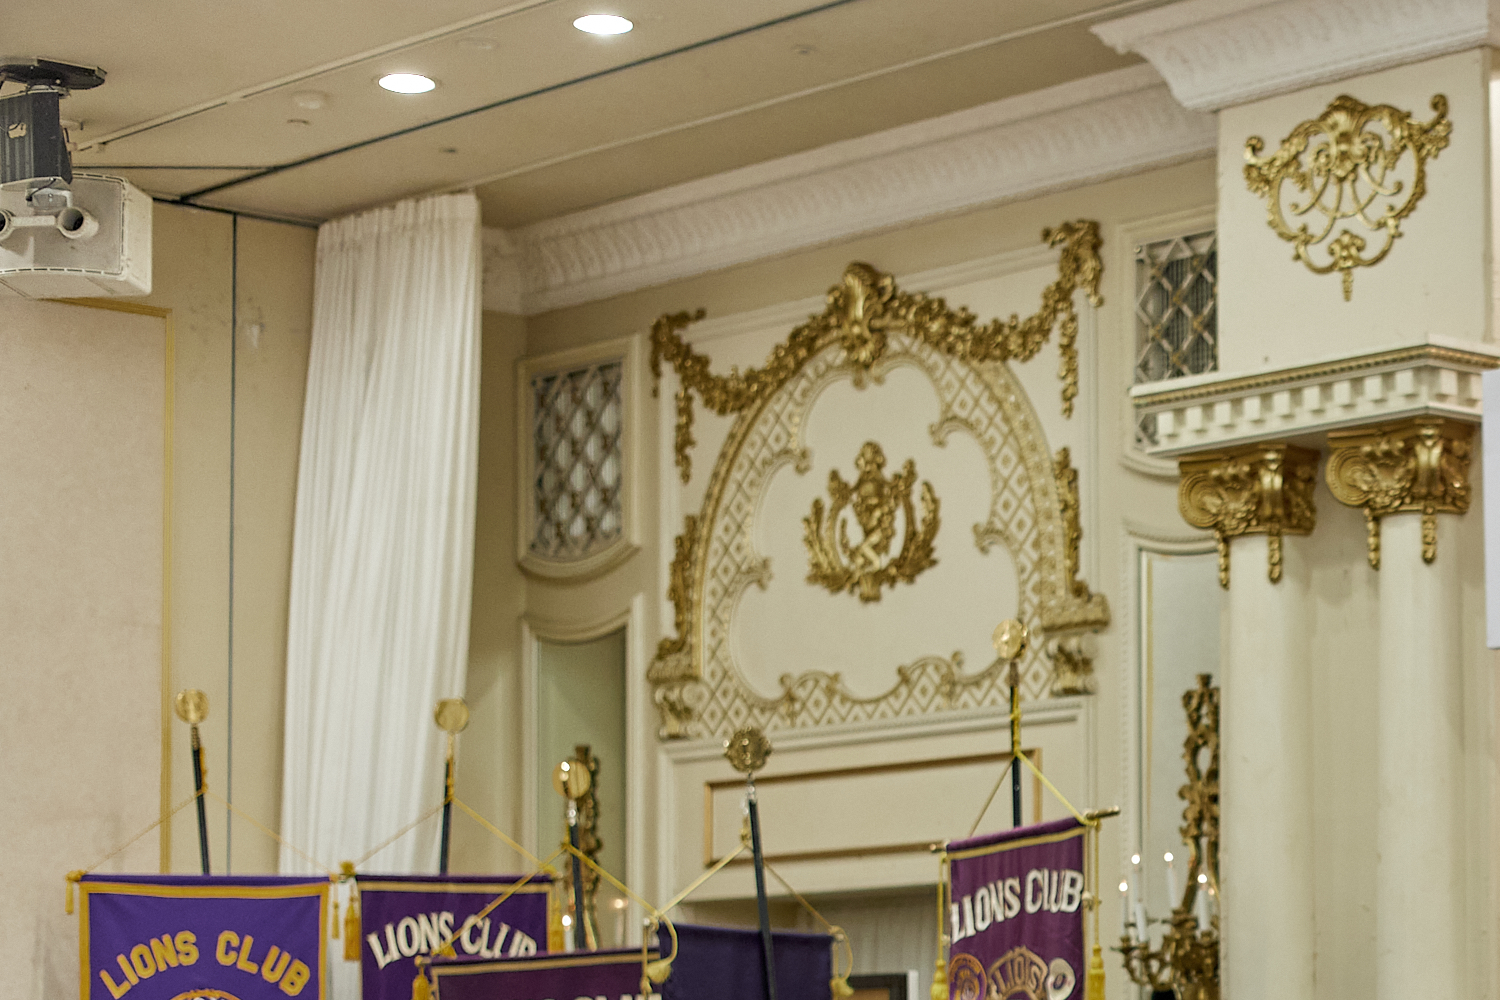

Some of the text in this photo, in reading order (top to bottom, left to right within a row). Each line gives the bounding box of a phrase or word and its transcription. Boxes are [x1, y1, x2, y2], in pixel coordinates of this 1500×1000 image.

[365, 911, 456, 971] LIONS
[951, 867, 1084, 945] LIONS CLUB
[100, 930, 311, 1000] LIONS CLUB
